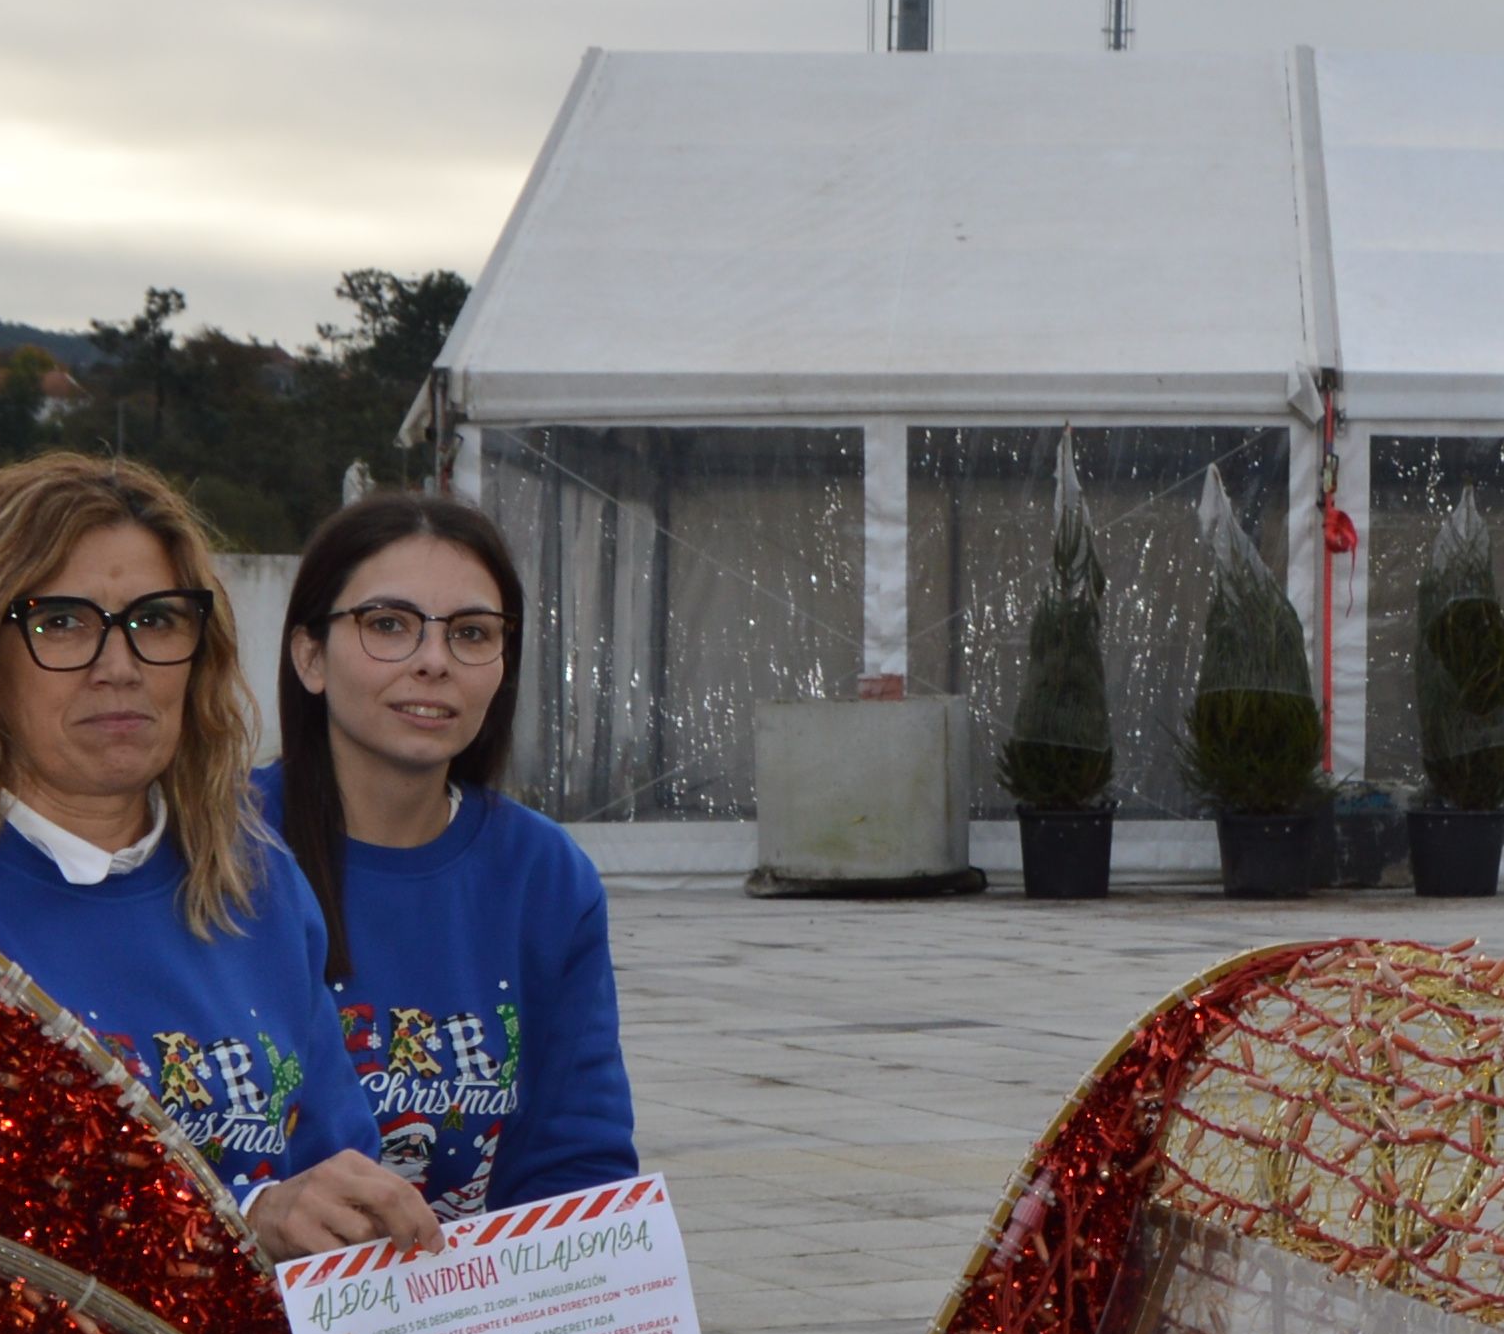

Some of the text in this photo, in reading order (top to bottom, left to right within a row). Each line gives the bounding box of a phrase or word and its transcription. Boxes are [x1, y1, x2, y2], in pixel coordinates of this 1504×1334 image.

[359, 1071, 519, 1117] Christmas
[307, 1218, 653, 1332] ALDEA NAVIDEÑA VILALONGA
[414, 1317, 428, 1332] DE
